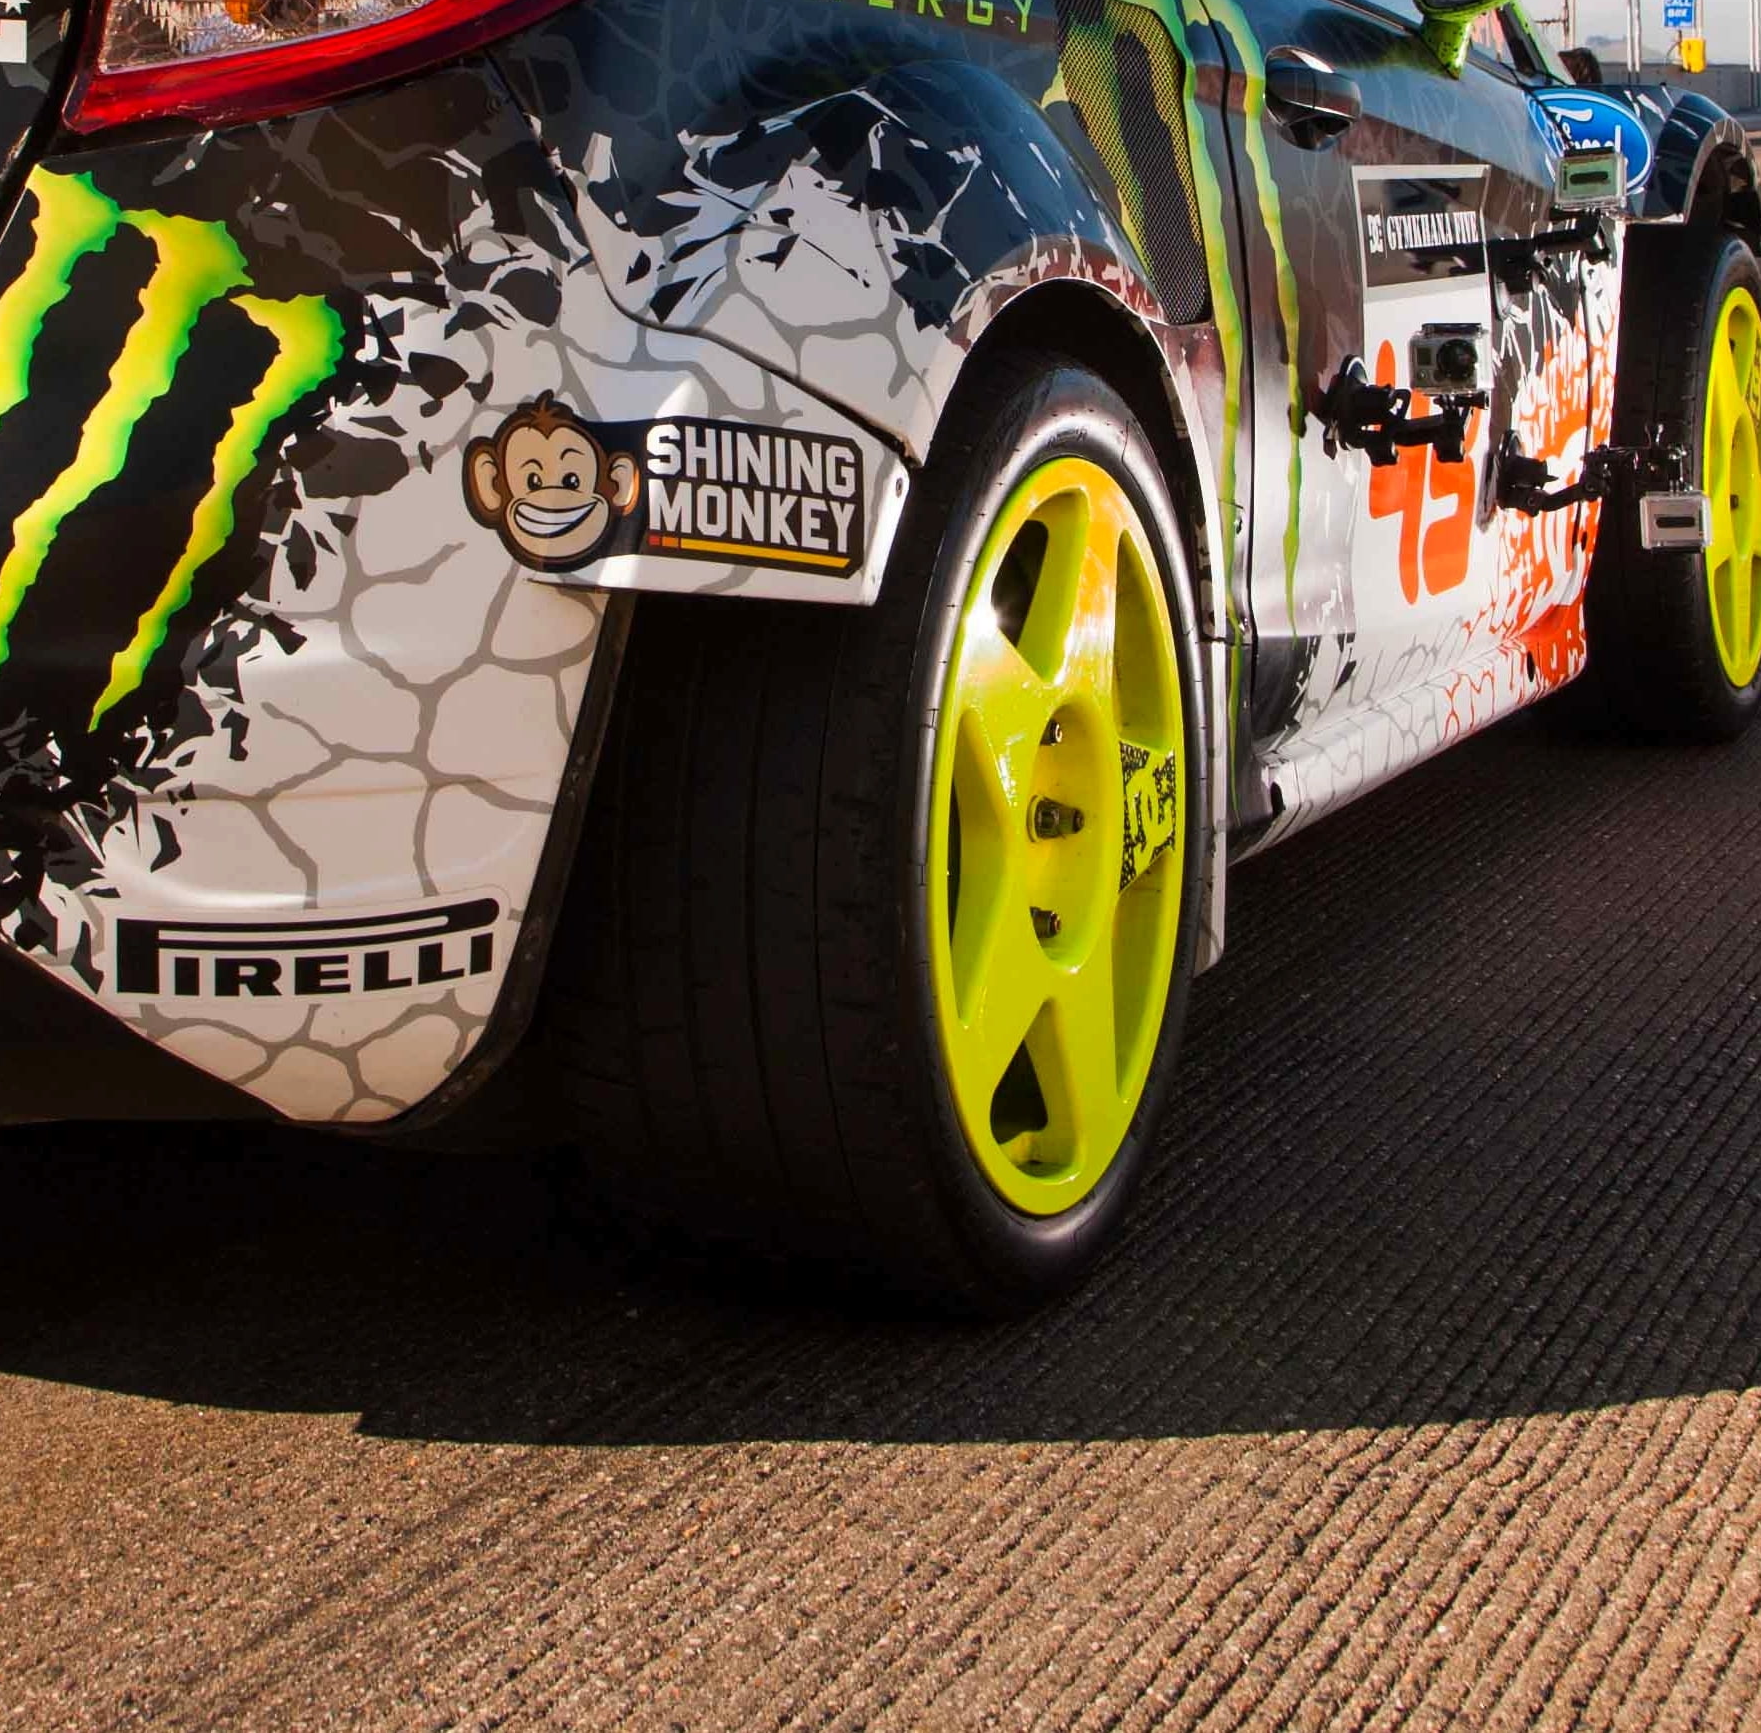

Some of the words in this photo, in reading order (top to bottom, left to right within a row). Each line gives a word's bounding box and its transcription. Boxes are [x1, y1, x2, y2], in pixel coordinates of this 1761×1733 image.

[1386, 212, 1454, 251] GYMKHANA
[645, 422, 858, 498] SHINING
[647, 486, 858, 555] MONKEY
[116, 896, 502, 998] PIRELLI
